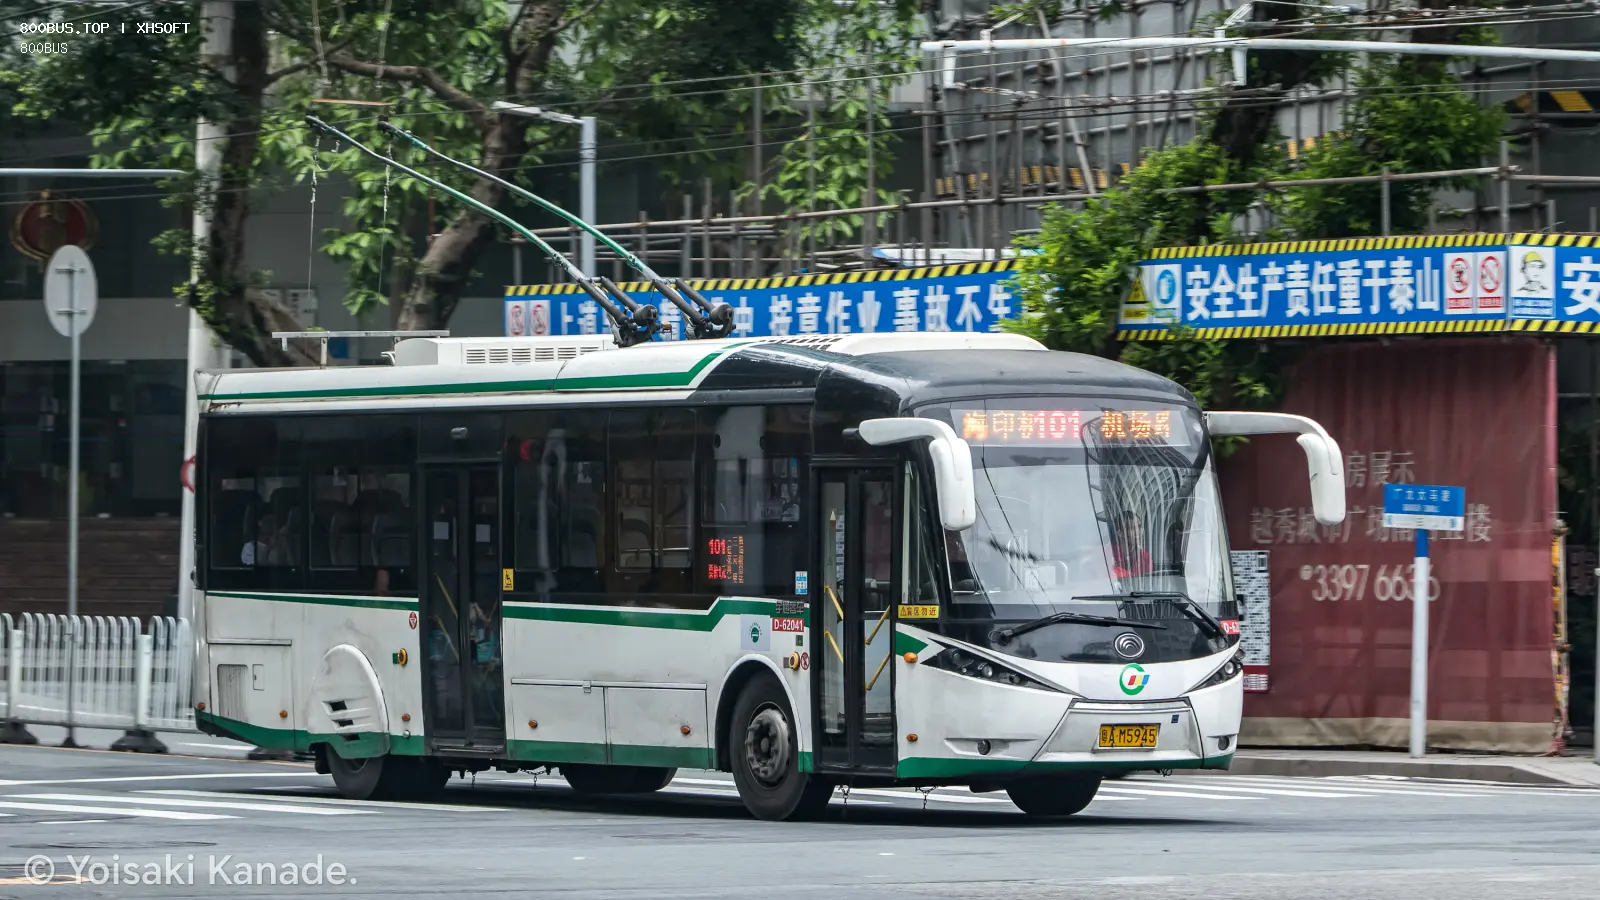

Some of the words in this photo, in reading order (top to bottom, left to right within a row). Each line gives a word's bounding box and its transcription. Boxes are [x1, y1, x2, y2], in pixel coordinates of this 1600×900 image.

[1185, 255, 1440, 321] 安全生产责任重于泰山
[1561, 255, 1600, 317] 安
[1034, 410, 1080, 439] 101
[708, 539, 726, 555] 101
[1311, 564, 1371, 602] 3397
[773, 618, 803, 632] D-62041
